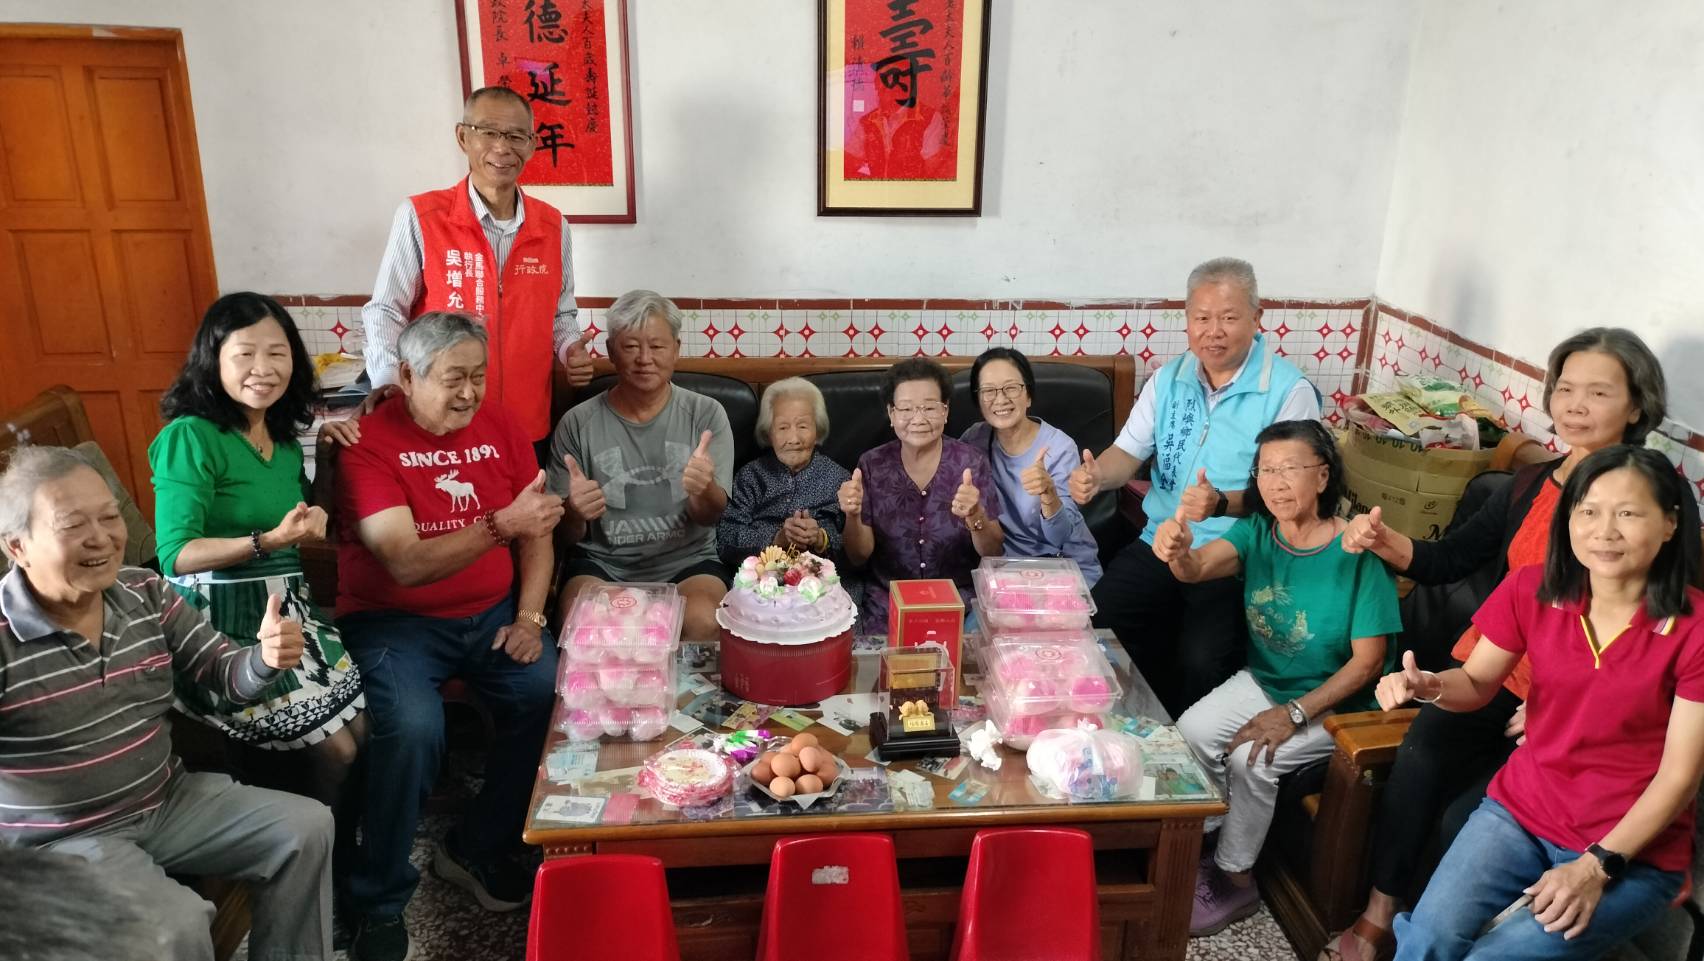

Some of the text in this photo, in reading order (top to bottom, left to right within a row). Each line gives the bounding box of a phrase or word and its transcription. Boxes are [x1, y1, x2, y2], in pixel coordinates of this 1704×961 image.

[446, 249, 465, 309] 吳增允
[513, 264, 550, 276] 行政院
[399, 449, 462, 468] SINCE
